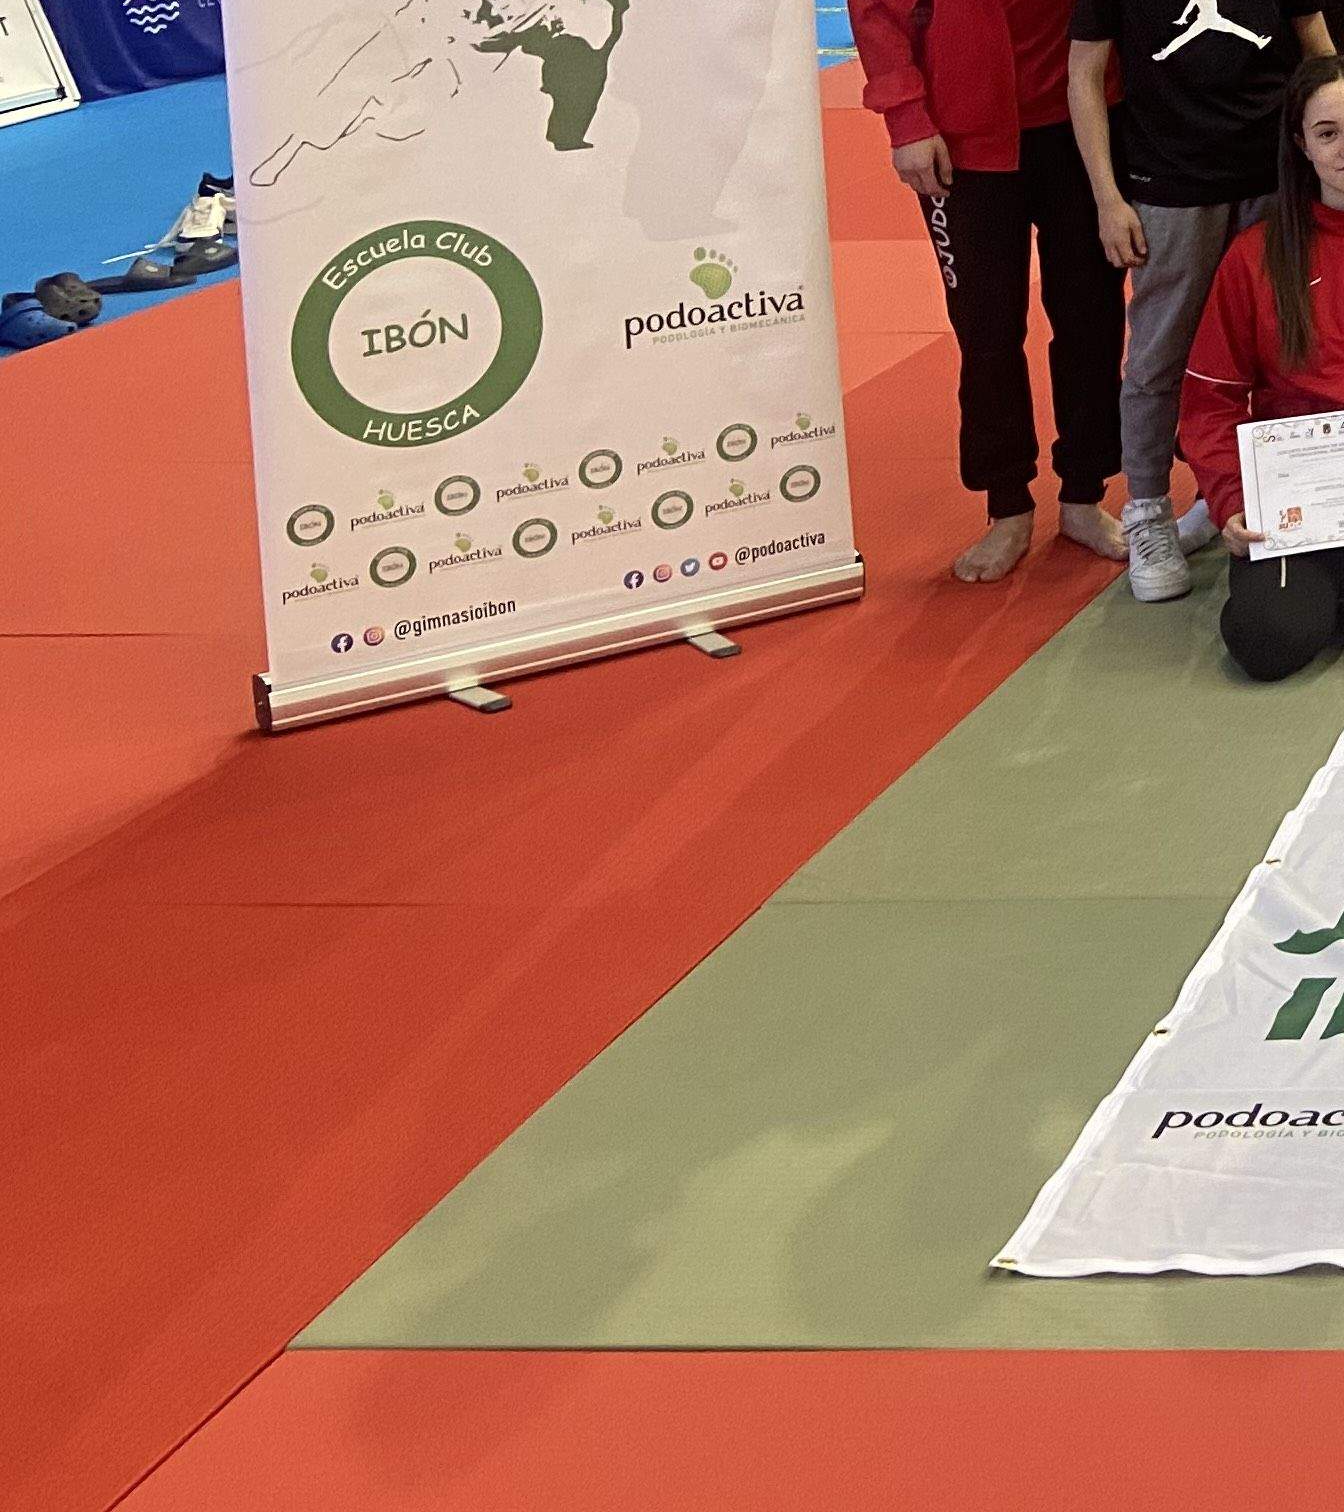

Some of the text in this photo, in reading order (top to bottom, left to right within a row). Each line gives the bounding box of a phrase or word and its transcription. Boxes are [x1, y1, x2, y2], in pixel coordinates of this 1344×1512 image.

[321, 228, 495, 292] Escuela Club
[361, 308, 470, 359] IBÓN
[625, 290, 805, 350] podoactiva
[361, 403, 481, 443] HUESCA
[351, 425, 836, 532] podoactiva podoactiva podoactiva podoactiva
[282, 490, 771, 605] podoactiva podoactiva podoactiva podoactiva
[735, 531, 826, 565] @podoactiva
[394, 599, 516, 640] @gimnasioibon
